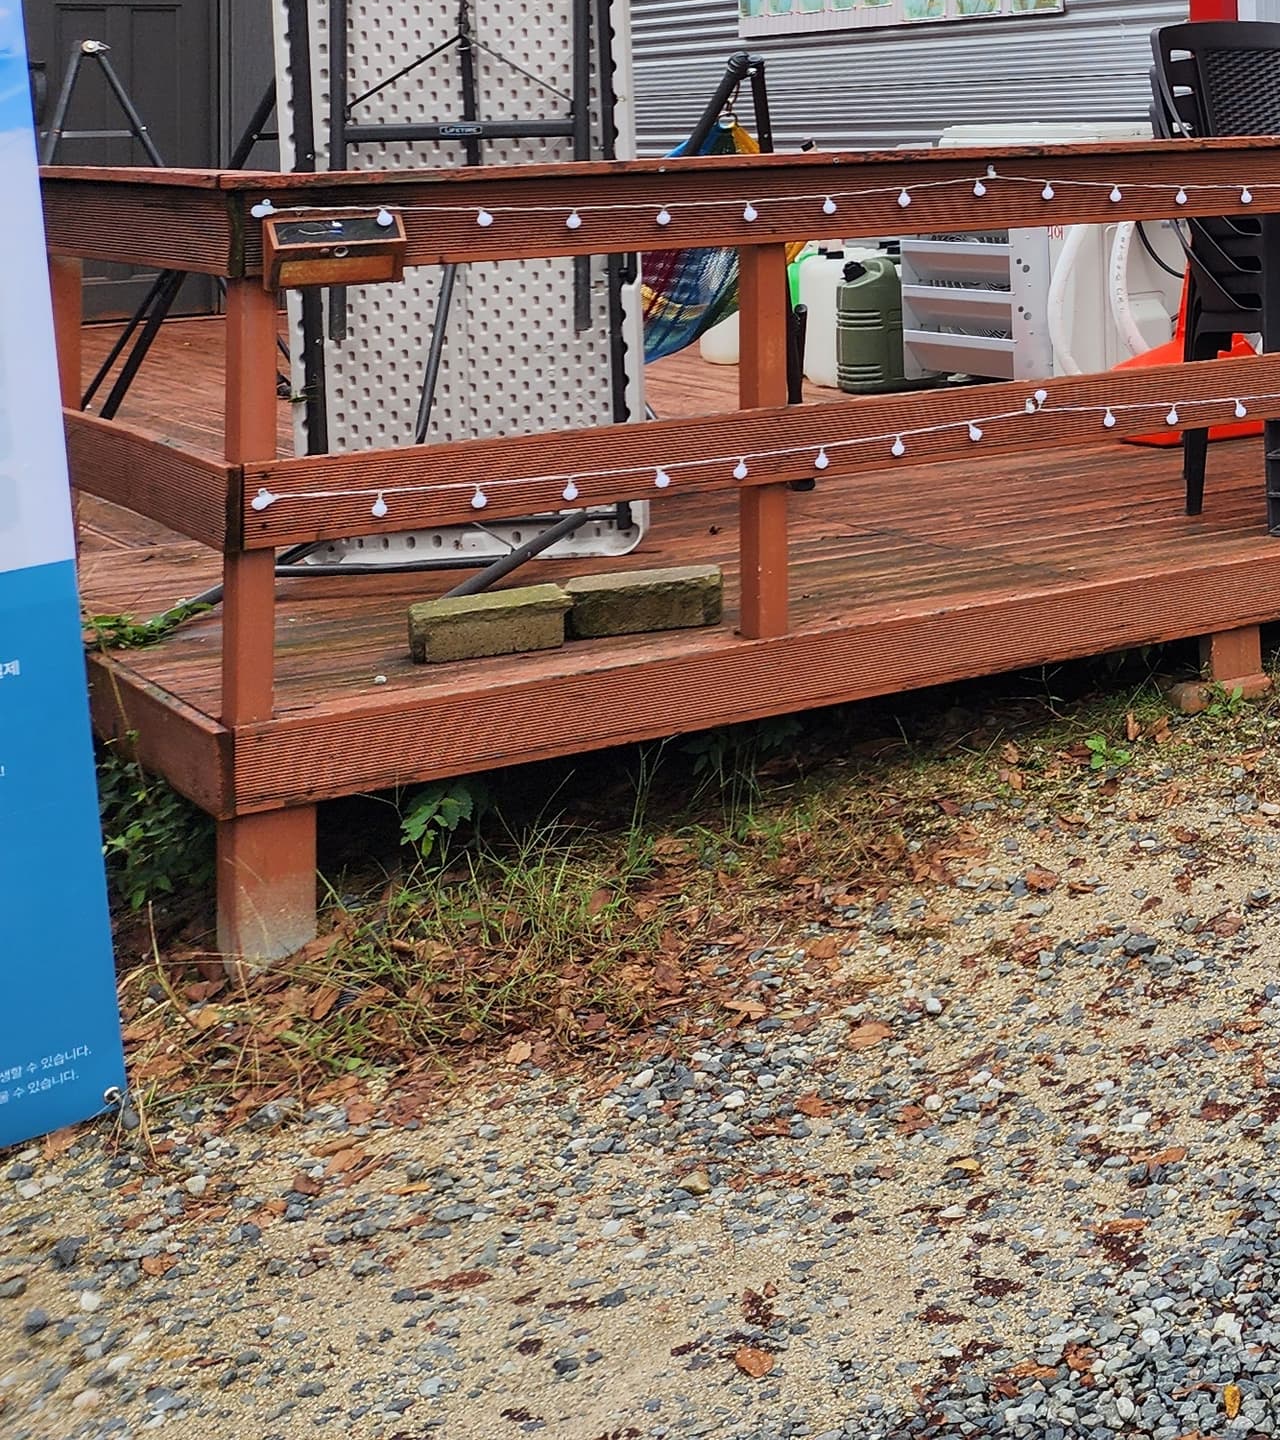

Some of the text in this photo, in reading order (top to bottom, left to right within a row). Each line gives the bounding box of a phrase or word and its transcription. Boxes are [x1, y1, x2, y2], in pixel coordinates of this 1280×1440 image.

[26, 1062, 38, 1074] 수
[40, 1045, 92, 1071] 있습니다.
[13, 1087, 25, 1099] 수
